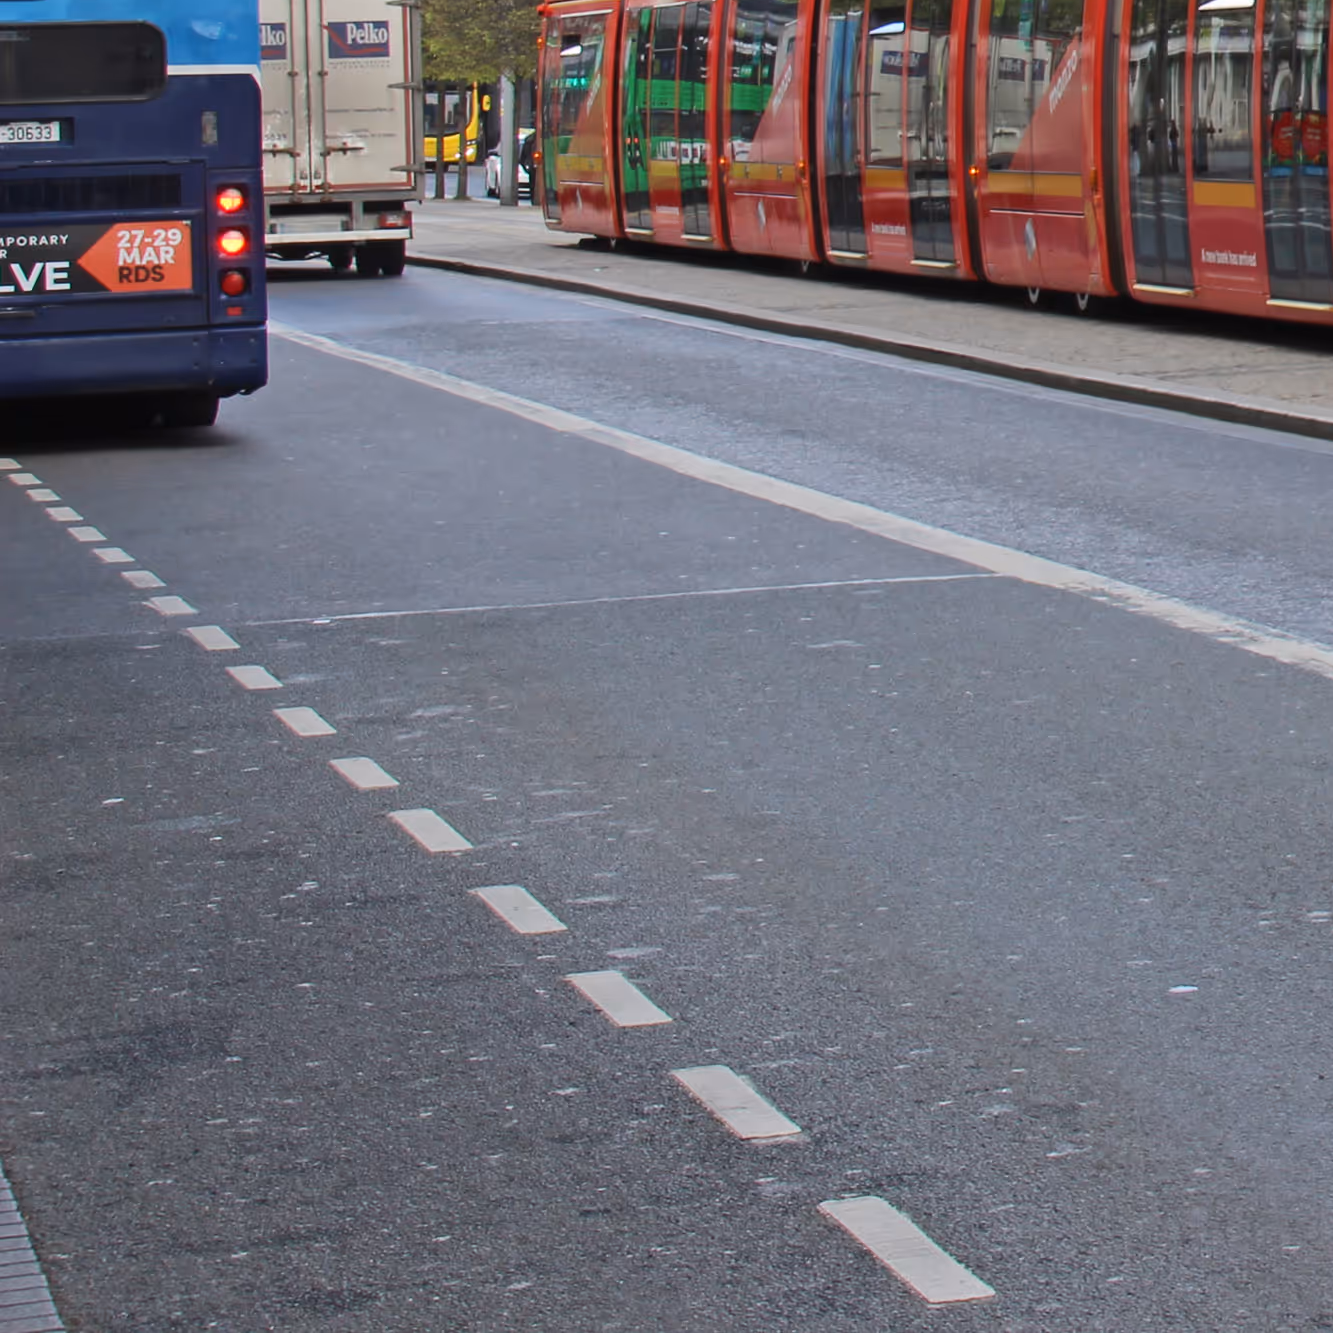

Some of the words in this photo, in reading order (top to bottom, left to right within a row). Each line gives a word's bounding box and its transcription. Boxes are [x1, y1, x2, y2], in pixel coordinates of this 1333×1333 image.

[259, 24, 286, 46] lko
[346, 23, 388, 45] Pelko
[116, 228, 183, 248] 27-29
[118, 246, 175, 266] MAR
[118, 265, 165, 284] RDS
